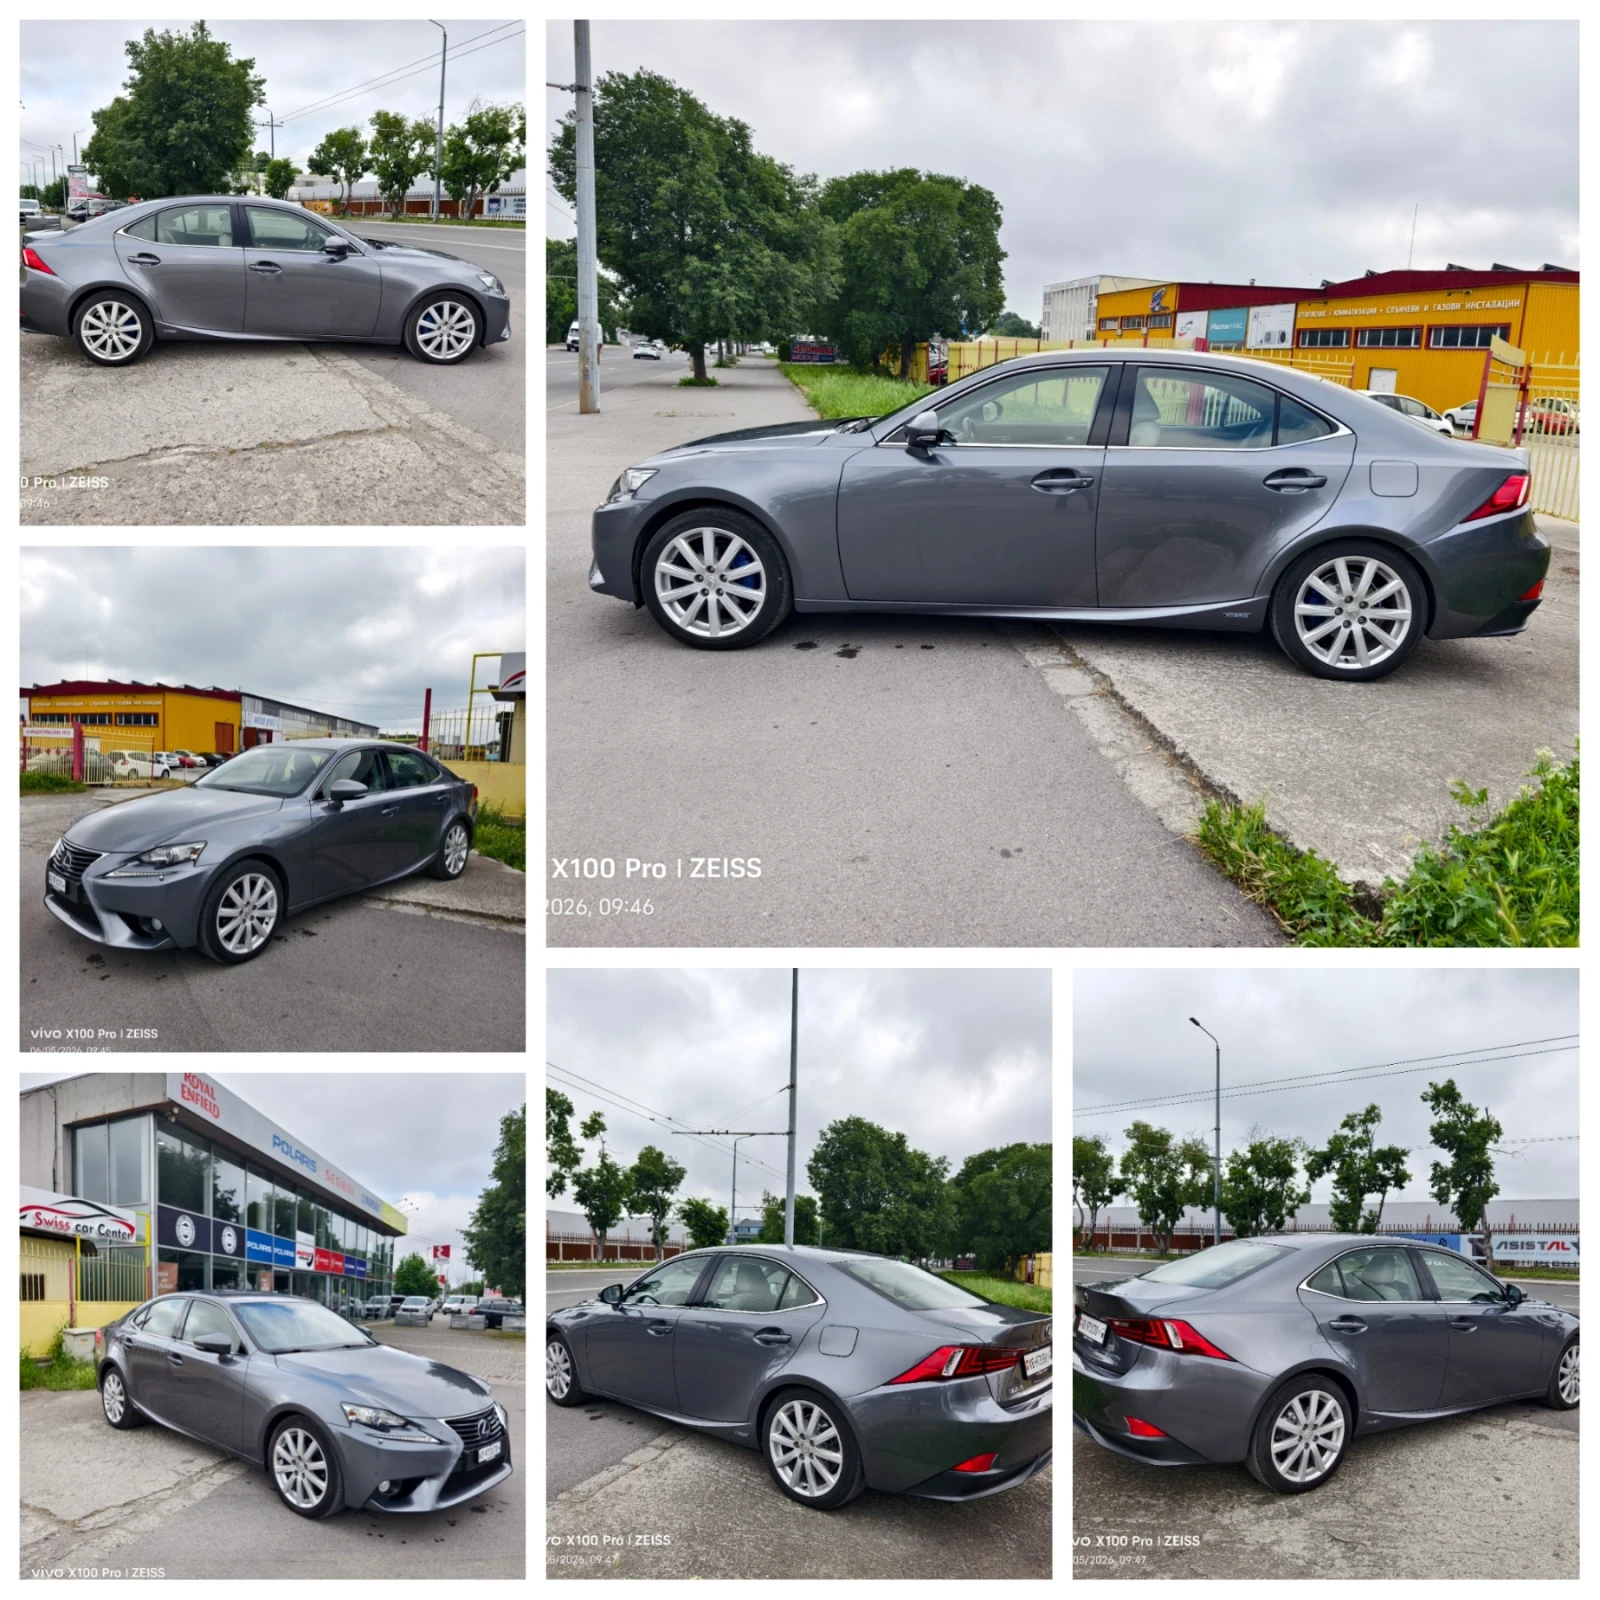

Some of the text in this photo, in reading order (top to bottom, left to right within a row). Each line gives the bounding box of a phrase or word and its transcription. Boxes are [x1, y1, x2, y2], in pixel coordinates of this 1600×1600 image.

[1385, 305, 1420, 314] СЛЪНЧЕВИ
[1432, 302, 1461, 311] ГАЗОВИ
[1465, 299, 1521, 309] ИНСТАЛАЦИИ
[183, 1073, 217, 1100] ROYAL
[180, 1083, 221, 1119] ENFIELD
[272, 1133, 317, 1174] POLARIS
[34, 1211, 132, 1240] Swiss car Center
[246, 1240, 272, 1254] POLARIS
[273, 1246, 295, 1258] POLARIS
[1495, 1240, 1571, 1251] ASISTAL
